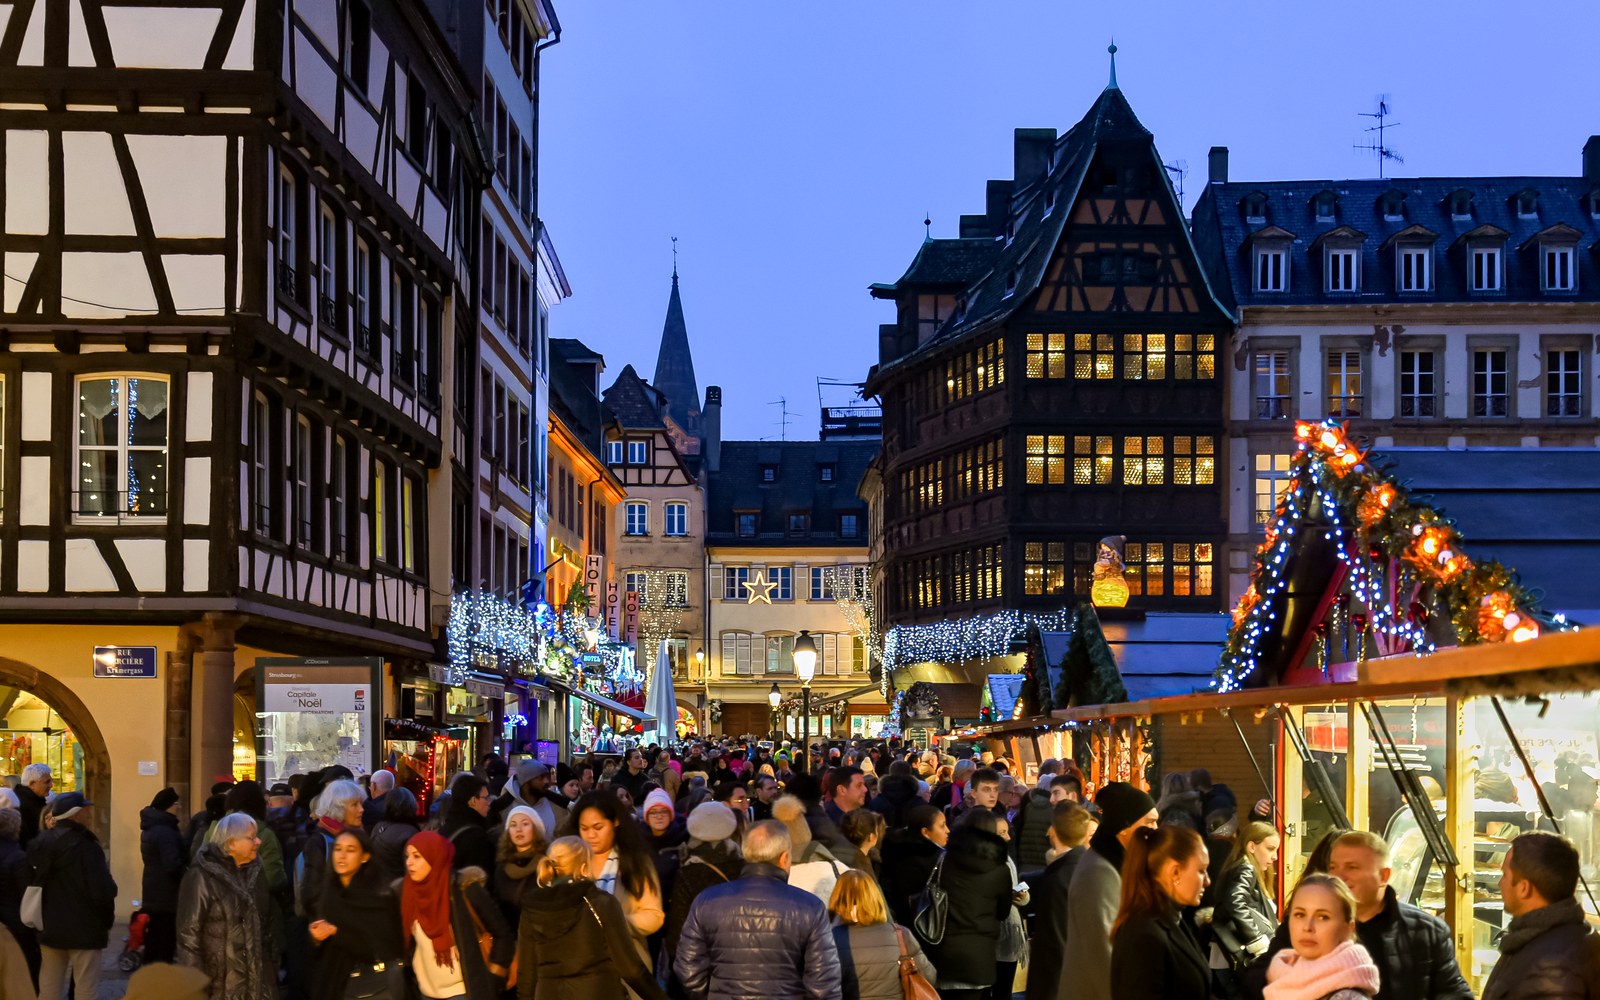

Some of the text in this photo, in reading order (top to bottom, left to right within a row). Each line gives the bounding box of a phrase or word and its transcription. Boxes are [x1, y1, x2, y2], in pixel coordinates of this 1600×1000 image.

[586, 557, 599, 618] HOTEL
[608, 583, 618, 638] HOTEL
[113, 656, 144, 665] RCIÈRE
[287, 691, 317, 699] Capitale
[298, 699, 322, 708] Noël
